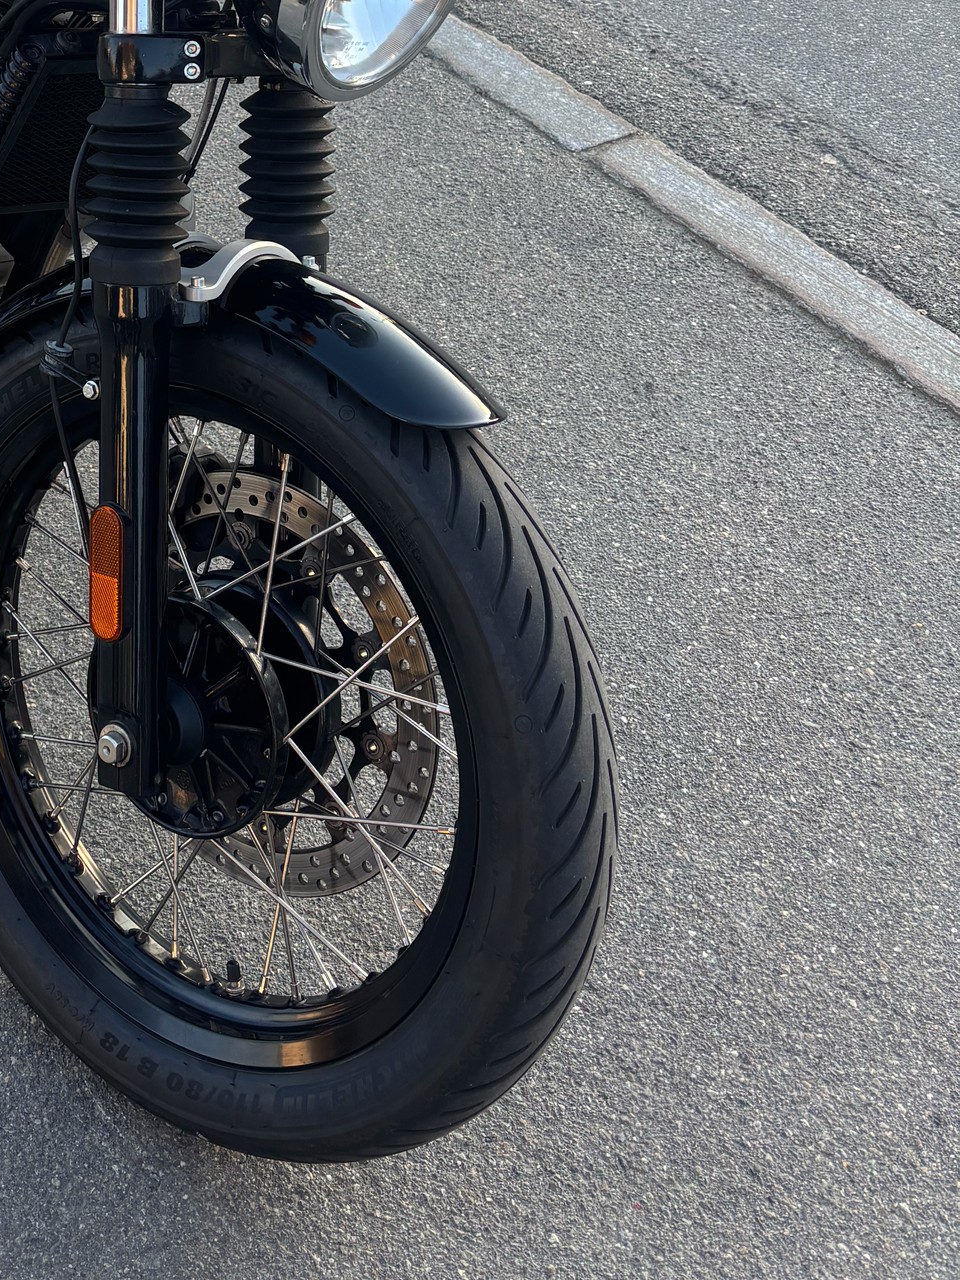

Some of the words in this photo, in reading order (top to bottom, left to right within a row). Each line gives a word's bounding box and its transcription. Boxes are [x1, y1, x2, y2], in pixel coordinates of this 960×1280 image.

[99, 1032, 132, 1062] 18
[136, 1056, 159, 1079] B
[165, 1071, 263, 1116] 110/80
